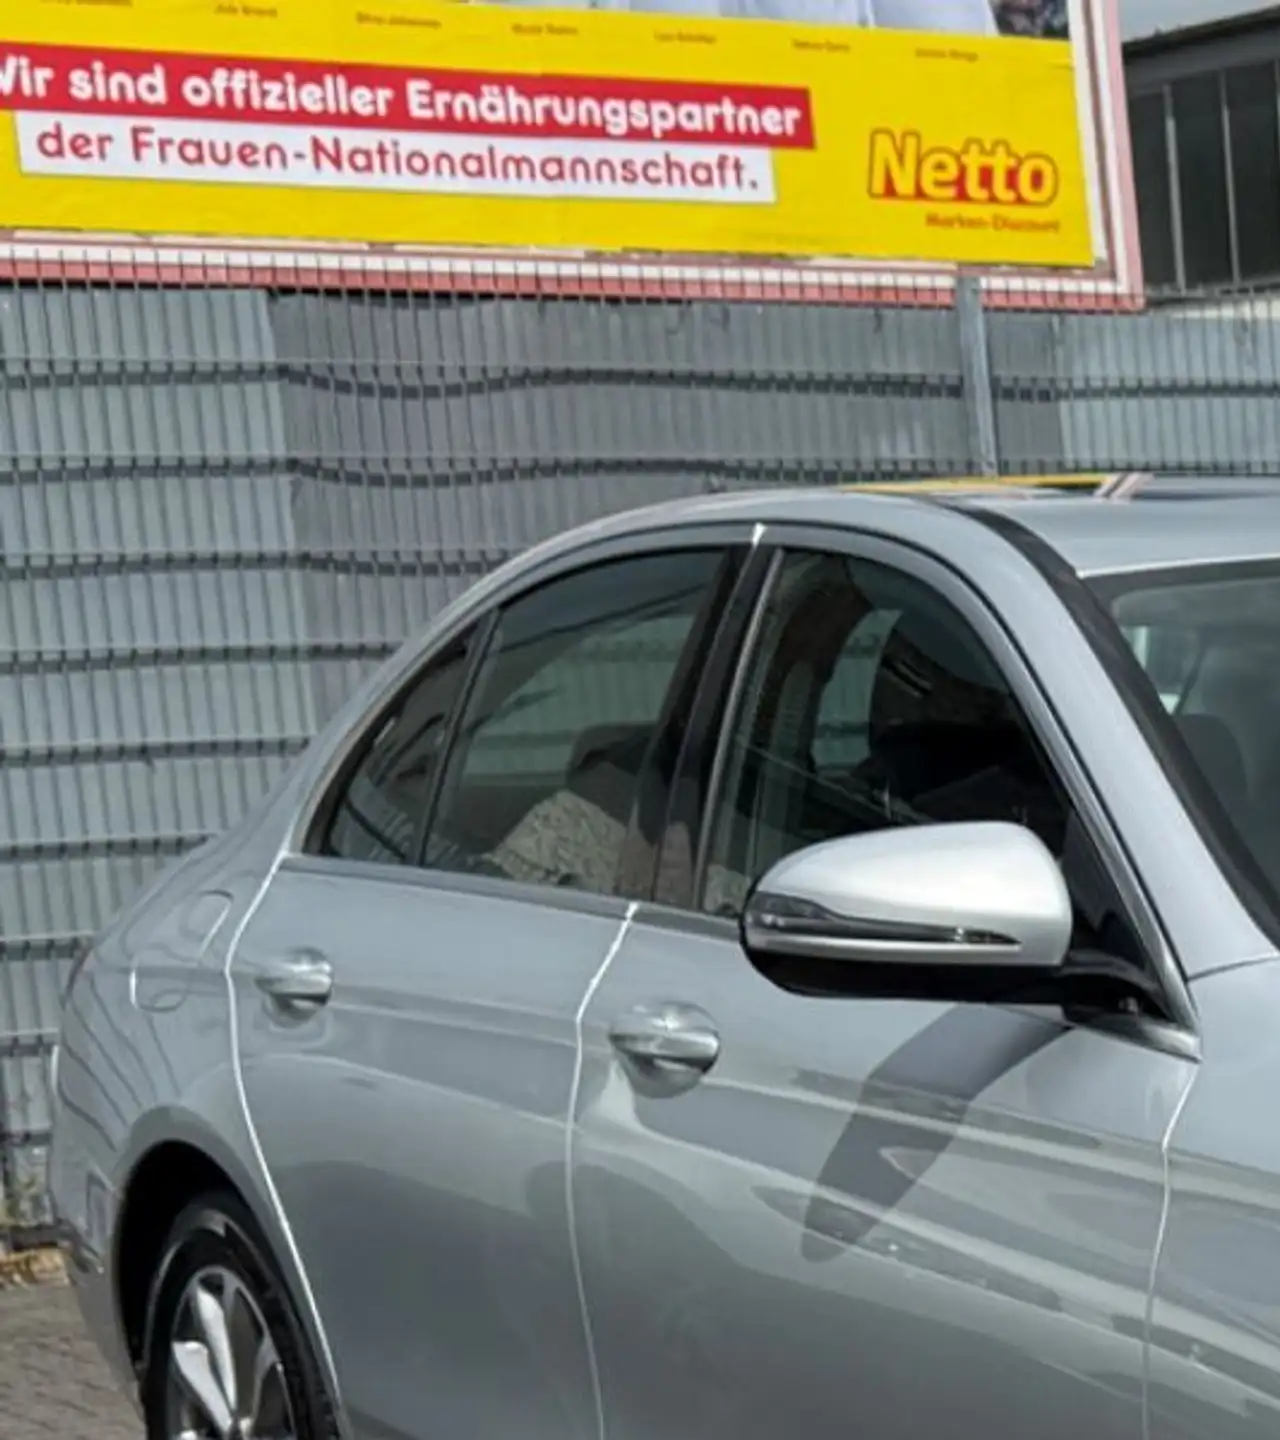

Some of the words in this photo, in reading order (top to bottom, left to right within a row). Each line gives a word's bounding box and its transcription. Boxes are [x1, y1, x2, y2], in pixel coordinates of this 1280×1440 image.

[68, 60, 168, 105] sind
[181, 67, 394, 118] offizieller
[405, 79, 802, 138] Ernährungspartner
[36, 121, 114, 162] der
[130, 125, 760, 190] Frauen-Nationalmannschaft.
[867, 127, 1059, 208] Netto
